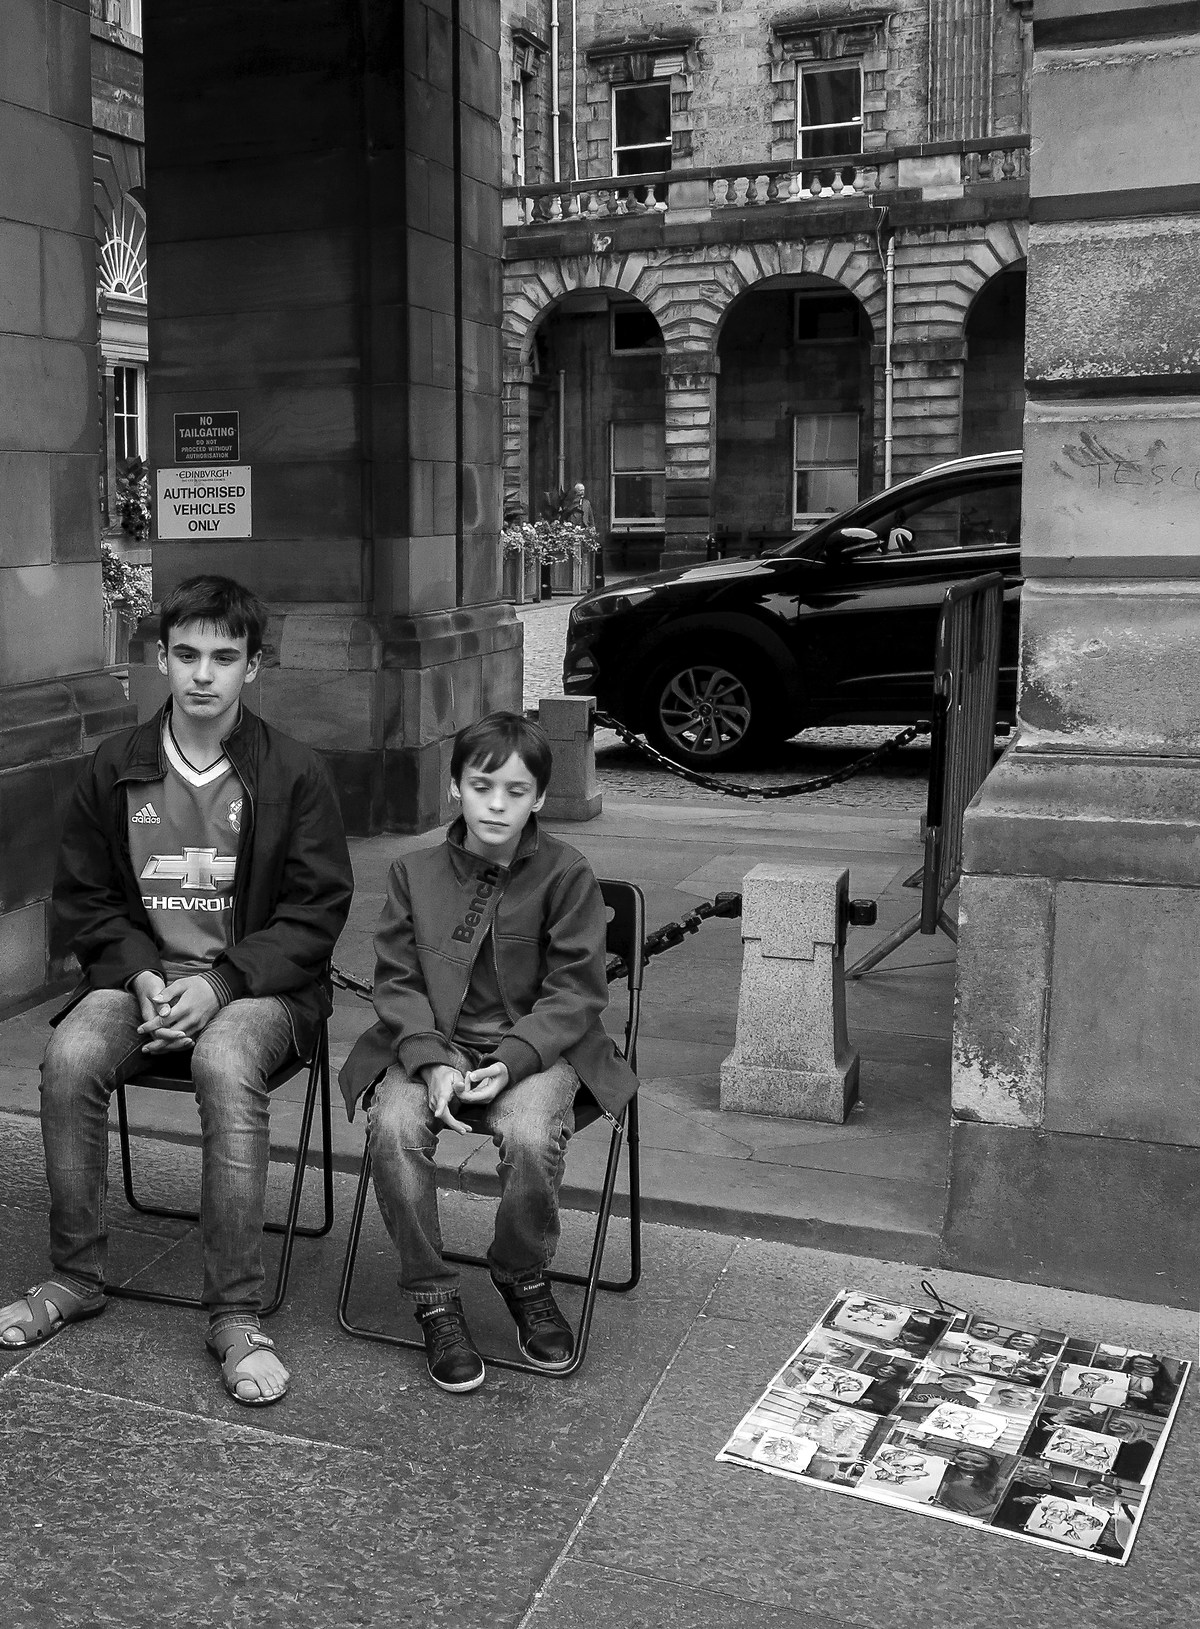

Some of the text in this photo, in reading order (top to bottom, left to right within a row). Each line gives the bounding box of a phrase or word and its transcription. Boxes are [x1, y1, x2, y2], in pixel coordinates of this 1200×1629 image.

[200, 416, 213, 426] NO
[179, 427, 235, 438] TAILGATING
[163, 486, 246, 500] AUTHORISED
[173, 502, 236, 516] VEHICLES
[188, 520, 220, 532] ONLY
[131, 814, 161, 824] adidas
